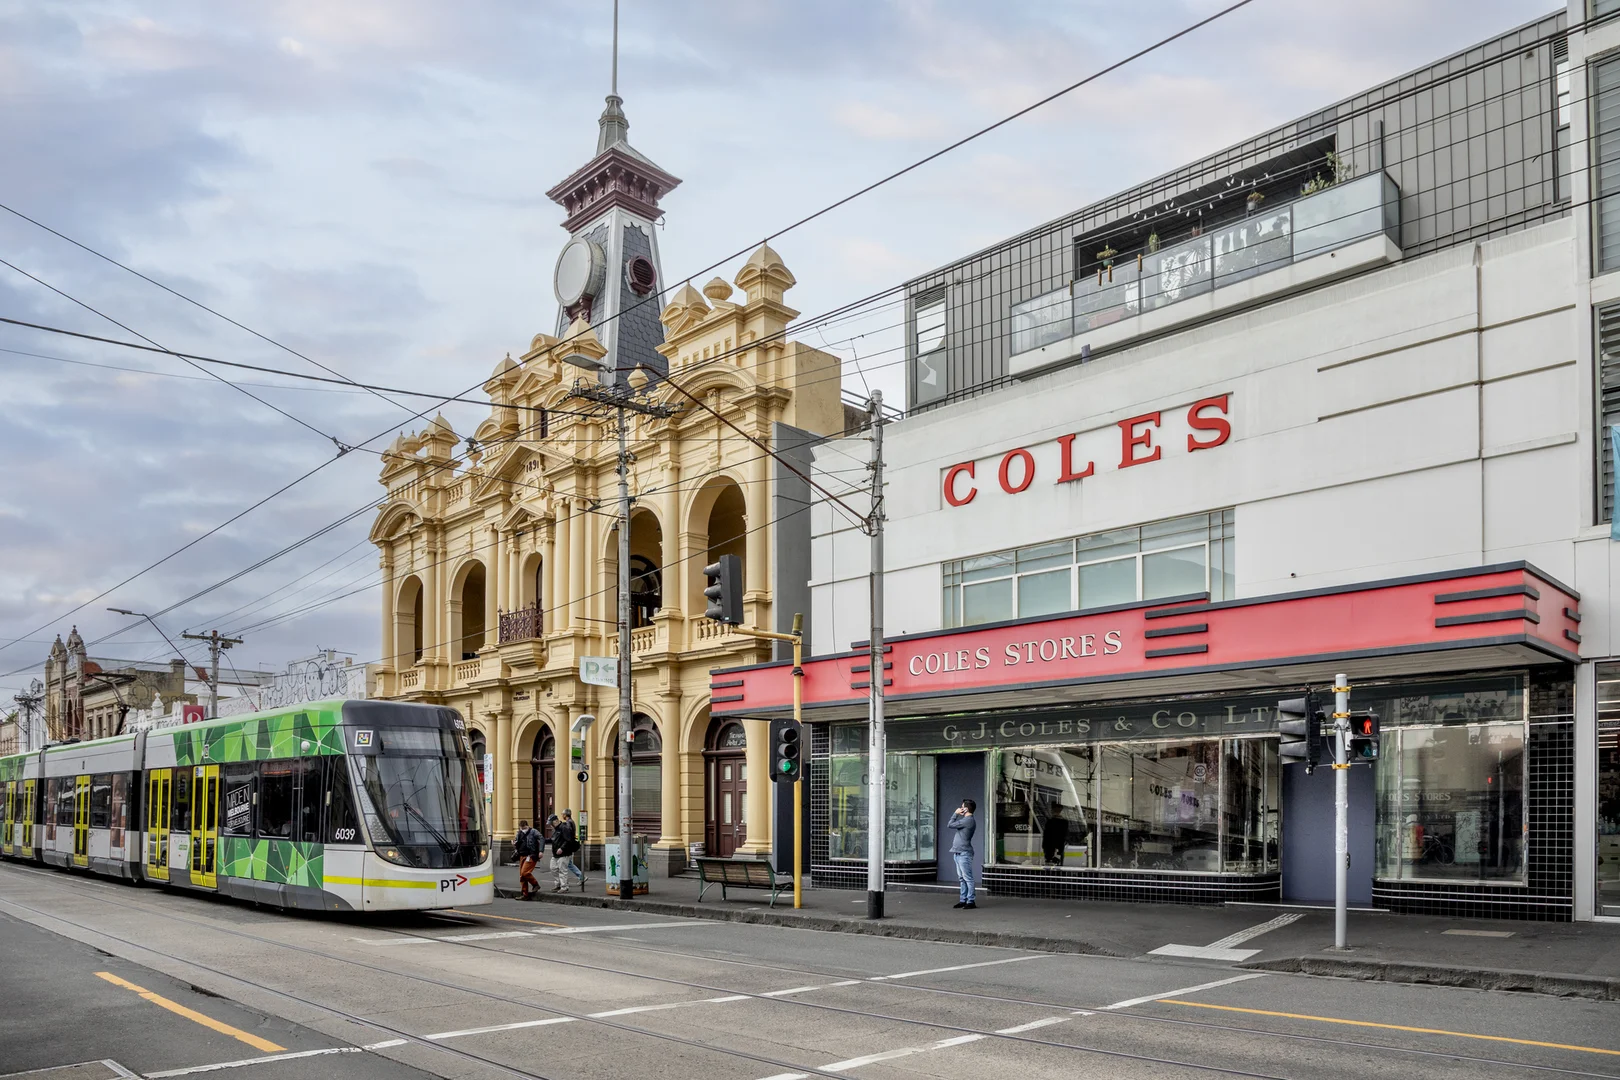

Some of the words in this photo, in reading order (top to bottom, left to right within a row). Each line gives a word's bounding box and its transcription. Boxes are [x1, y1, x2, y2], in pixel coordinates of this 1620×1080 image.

[943, 394, 1231, 507] COLES
[526, 459, 540, 473] 1891
[908, 646, 991, 676] COLES
[1004, 630, 1123, 666] STORES
[1113, 716, 1133, 732] &
[335, 827, 356, 841] 6039
